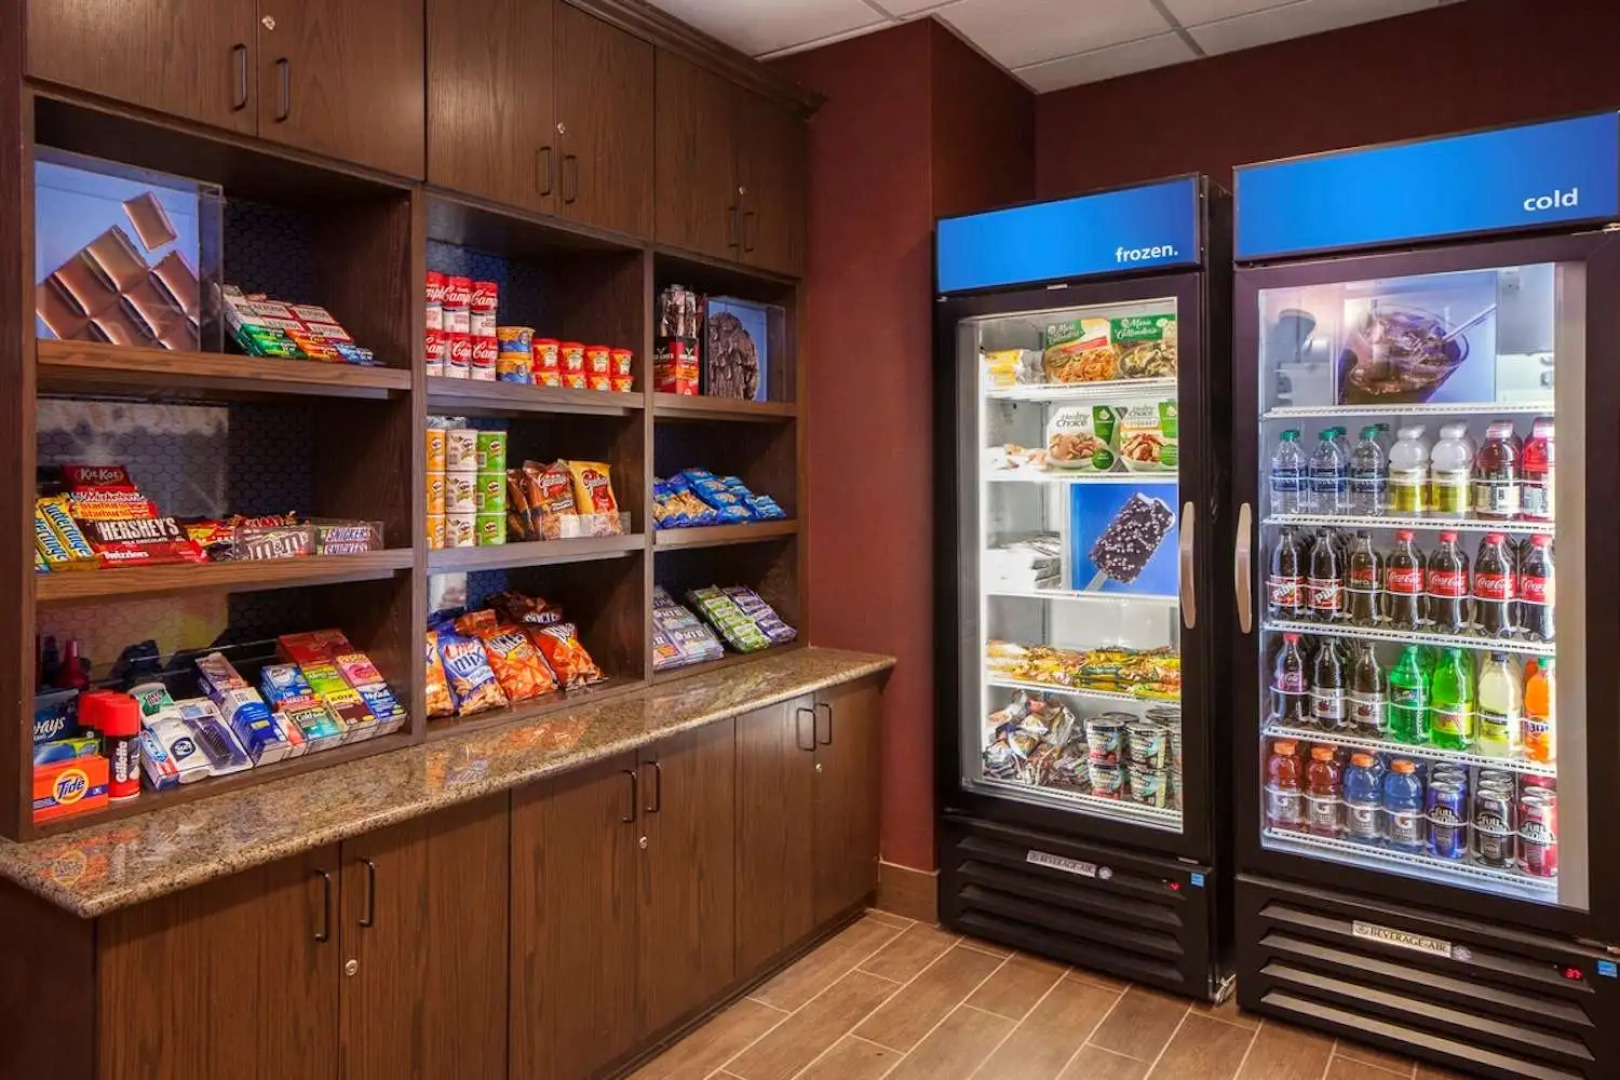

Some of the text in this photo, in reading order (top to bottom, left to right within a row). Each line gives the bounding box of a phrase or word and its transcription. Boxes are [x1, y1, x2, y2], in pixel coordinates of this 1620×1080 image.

[1523, 187, 1578, 211] cold
[1115, 244, 1177, 262] frozen.
[1056, 418, 1088, 428] Choice
[101, 517, 179, 541] HERSHEY'S
[454, 646, 486, 672] mix
[115, 741, 128, 783] Gillette
[57, 779, 86, 798] Tide
[1370, 927, 1450, 953] BEVERAGE-AIR
